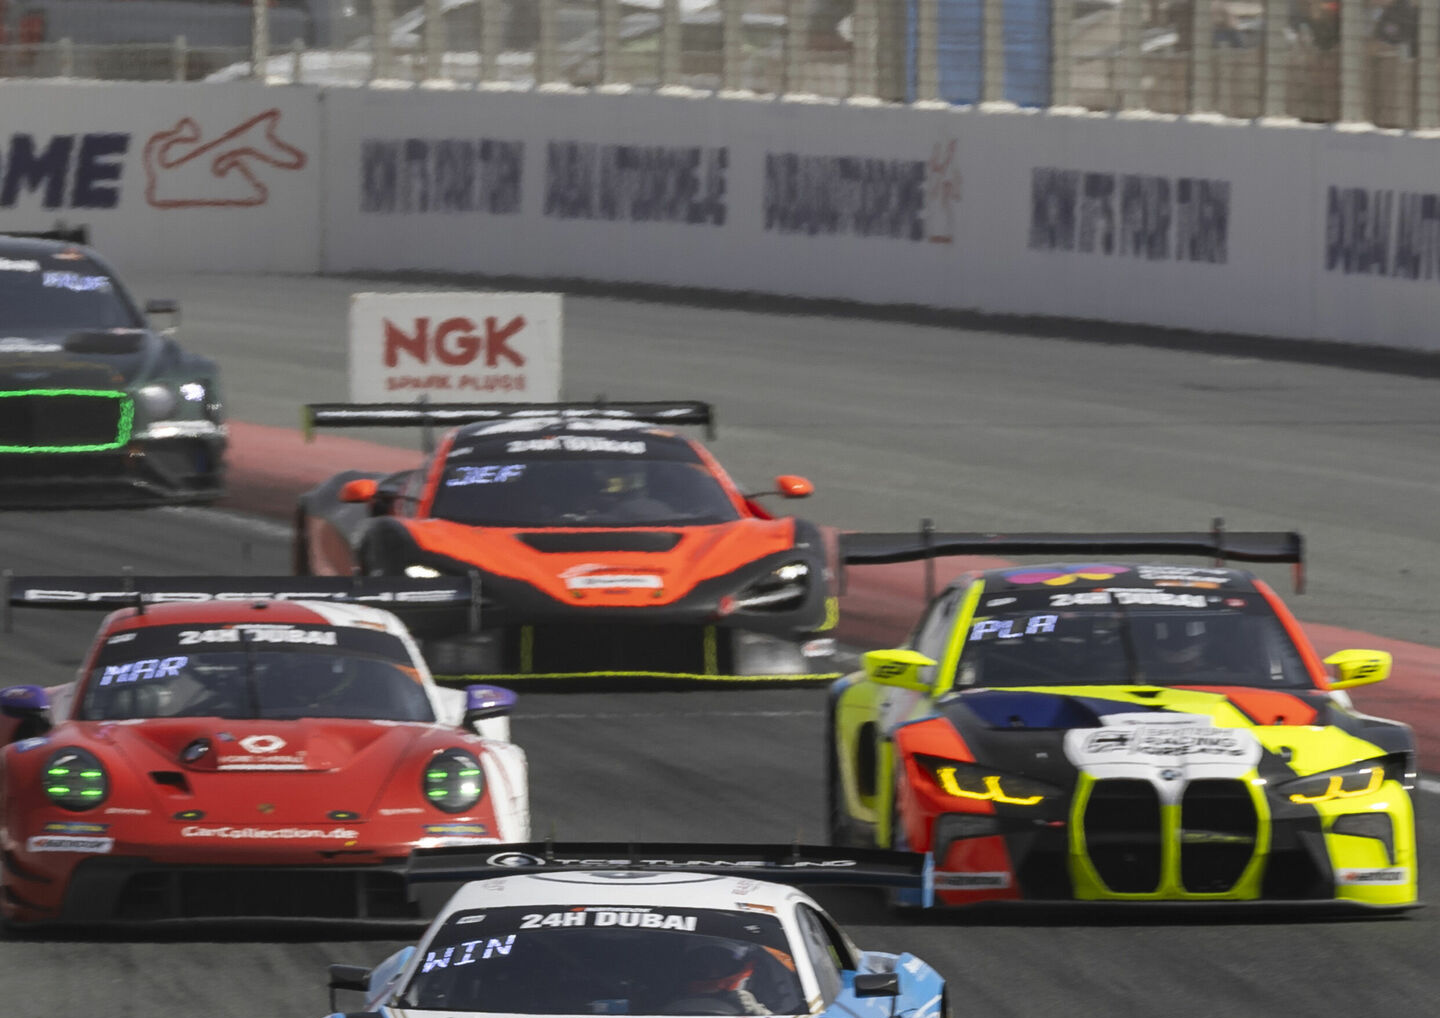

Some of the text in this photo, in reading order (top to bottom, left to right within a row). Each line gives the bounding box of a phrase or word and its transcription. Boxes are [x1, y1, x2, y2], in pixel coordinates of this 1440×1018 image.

[382, 314, 527, 369] NGK
[969, 615, 1058, 641] PLA
[100, 656, 189, 685] MAR
[520, 911, 698, 931] 24H DUBAI
[421, 934, 517, 973] WIN
